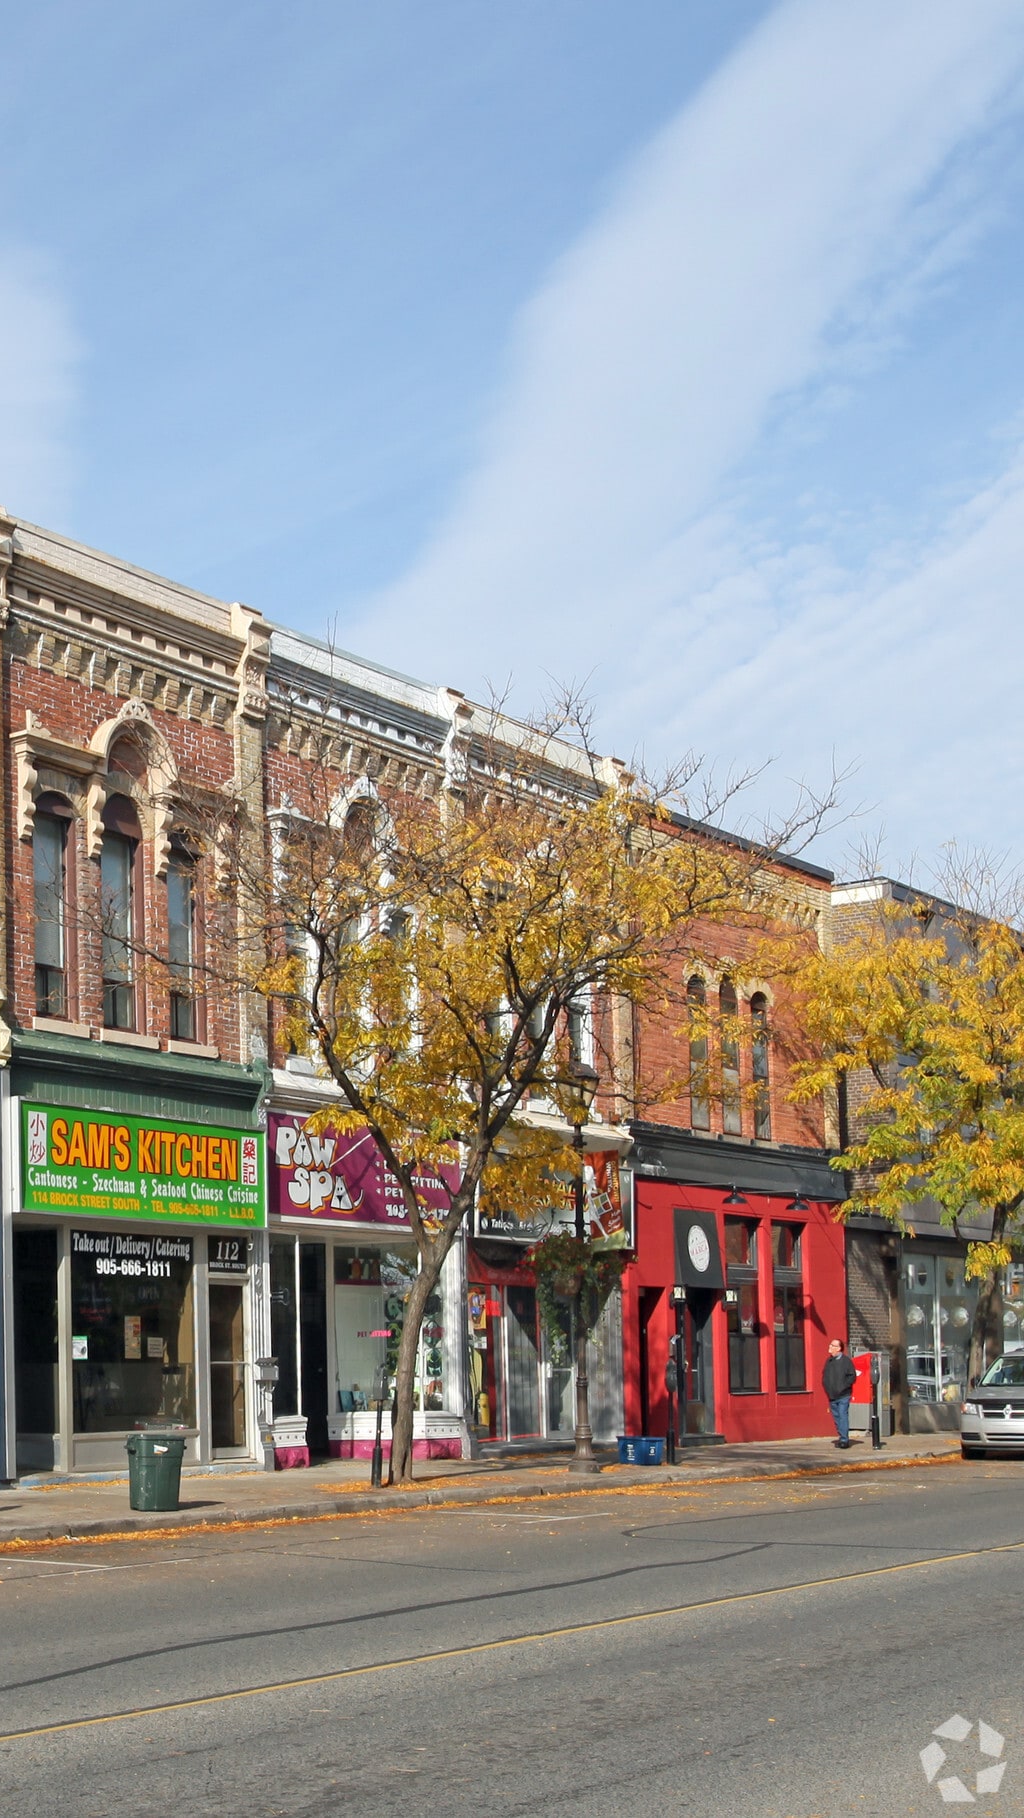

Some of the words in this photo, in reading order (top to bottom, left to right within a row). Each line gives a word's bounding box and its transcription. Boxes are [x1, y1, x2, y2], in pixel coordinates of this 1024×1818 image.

[51, 1117, 131, 1172] SAM'S
[138, 1128, 238, 1182] KITCHEN
[275, 1119, 336, 1169] PAW
[28, 1167, 78, 1190] Cantonese
[92, 1173, 136, 1194] Szechuan
[140, 1178, 147, 1198] &
[151, 1178, 187, 1199] Seafood
[190, 1182, 223, 1202] Chinese
[227, 1185, 258, 1204] Cuisine
[32, 1191, 49, 1204] 114
[50, 1191, 79, 1206] BROCK
[80, 1194, 111, 1209] STREET
[113, 1197, 140, 1211] SOUTH
[288, 1167, 358, 1211] SPA
[73, 1232, 94, 1252] Take
[95, 1236, 109, 1253] out
[115, 1235, 151, 1259] Delivery
[156, 1238, 190, 1261] Catering
[216, 1241, 239, 1260] 112
[96, 1258, 171, 1277] 905-666-1811
